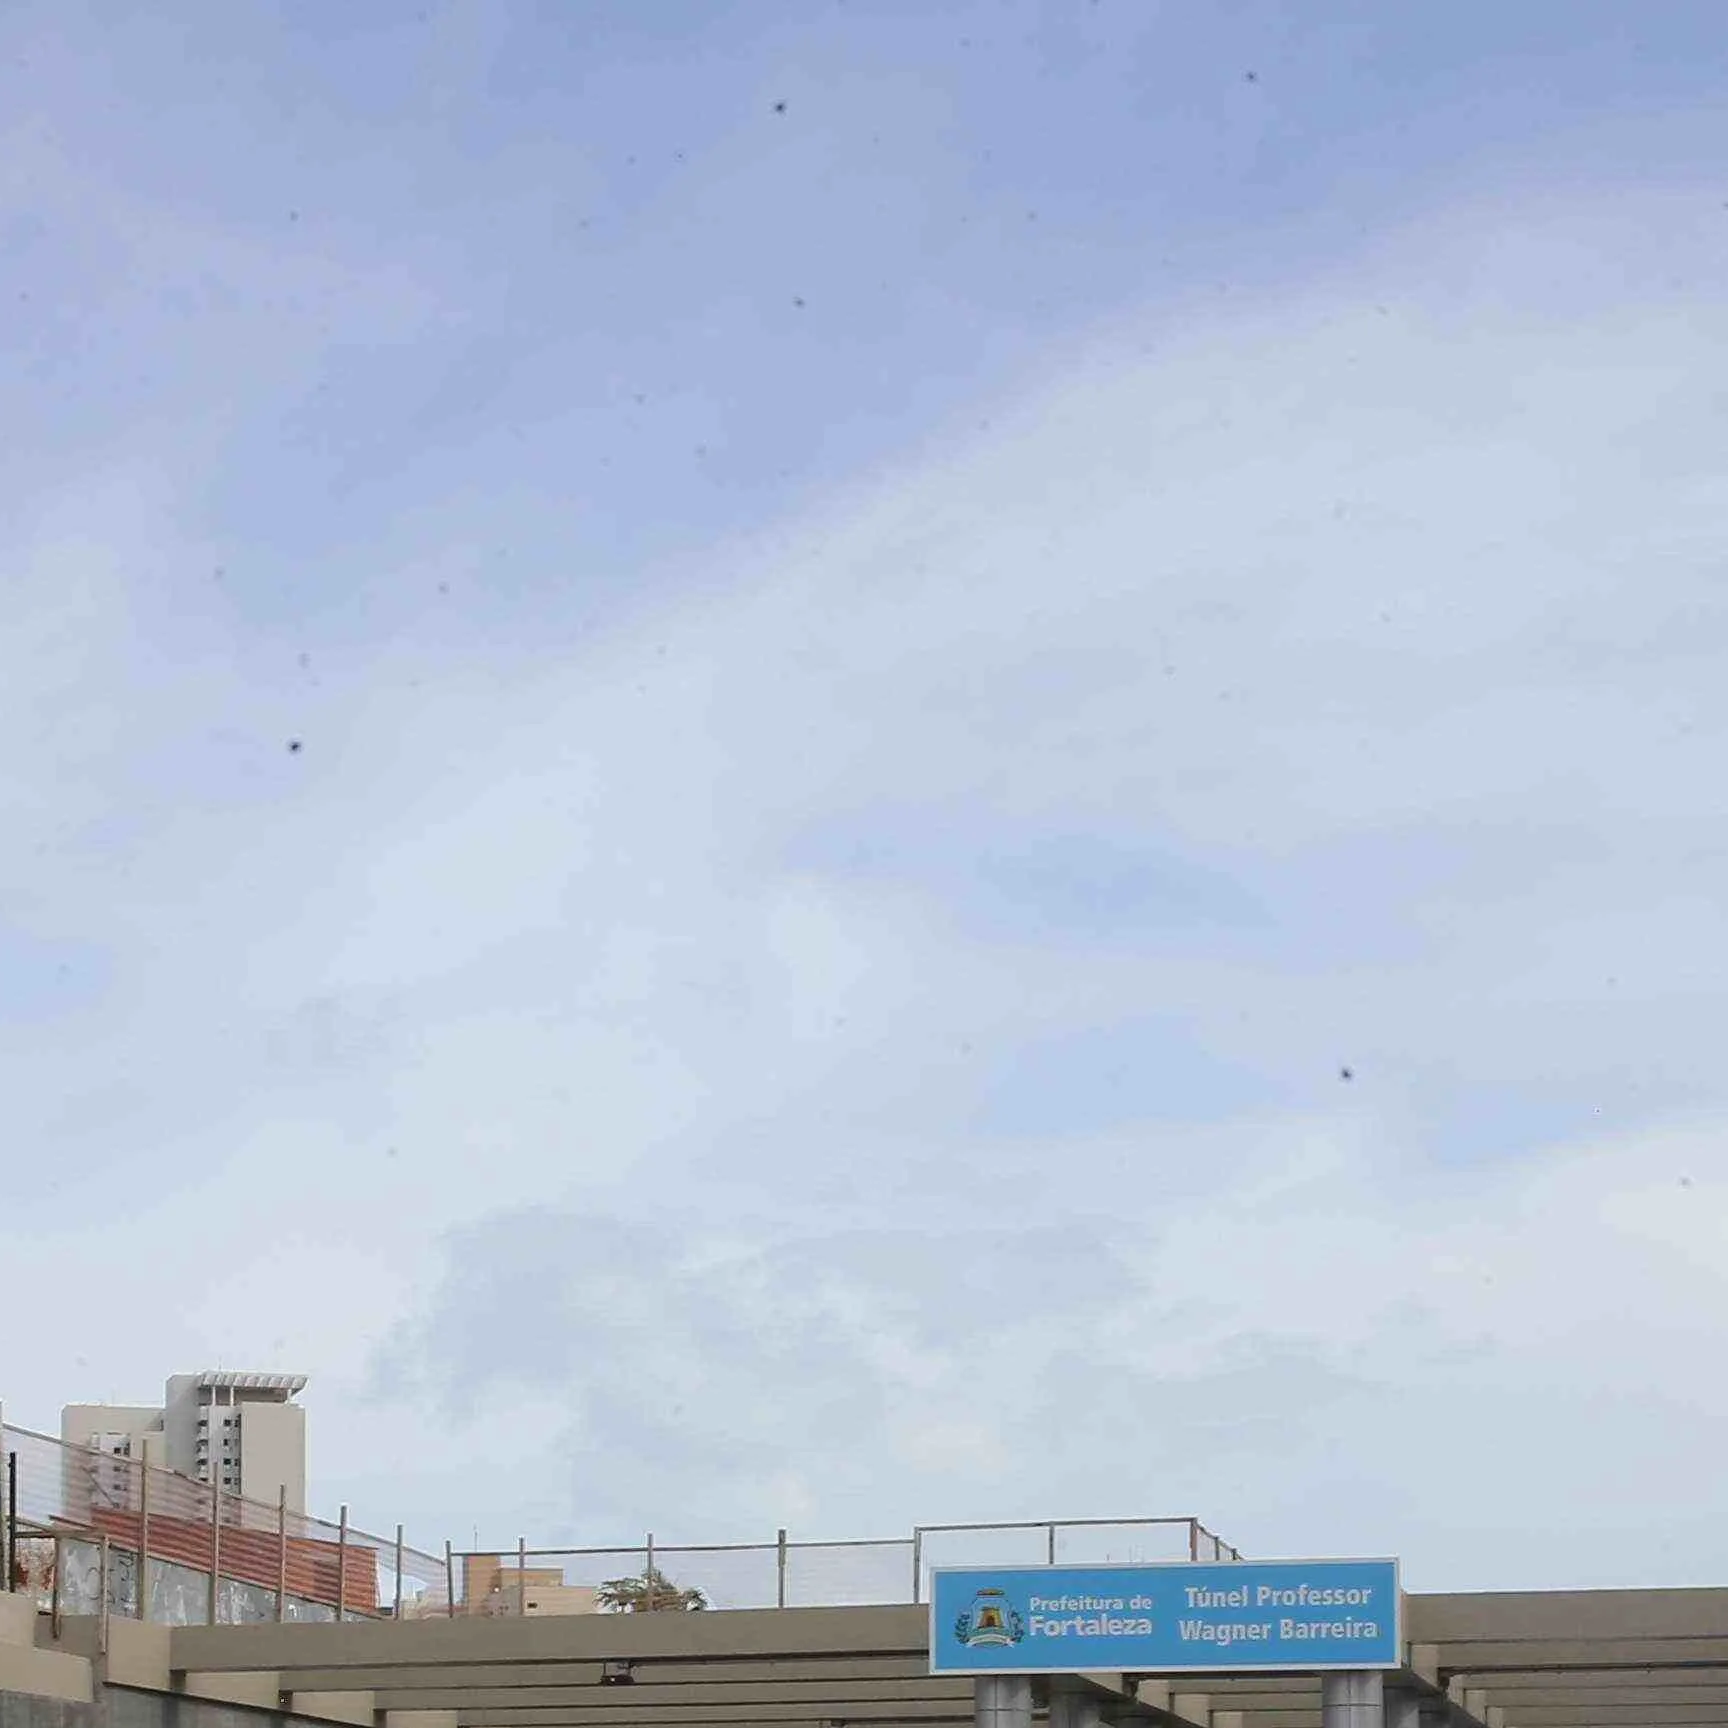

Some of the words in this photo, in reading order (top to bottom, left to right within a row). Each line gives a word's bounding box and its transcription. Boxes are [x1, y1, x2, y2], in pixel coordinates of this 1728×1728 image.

[1029, 1596, 1123, 1612] Prefeitura
[1129, 1594, 1153, 1610] de
[1184, 1585, 1249, 1608] Túnel
[1255, 1583, 1372, 1607] Professor
[1029, 1613, 1153, 1637] Fortaleza
[1178, 1619, 1272, 1646] Wagner
[1279, 1616, 1378, 1640] Barreira
